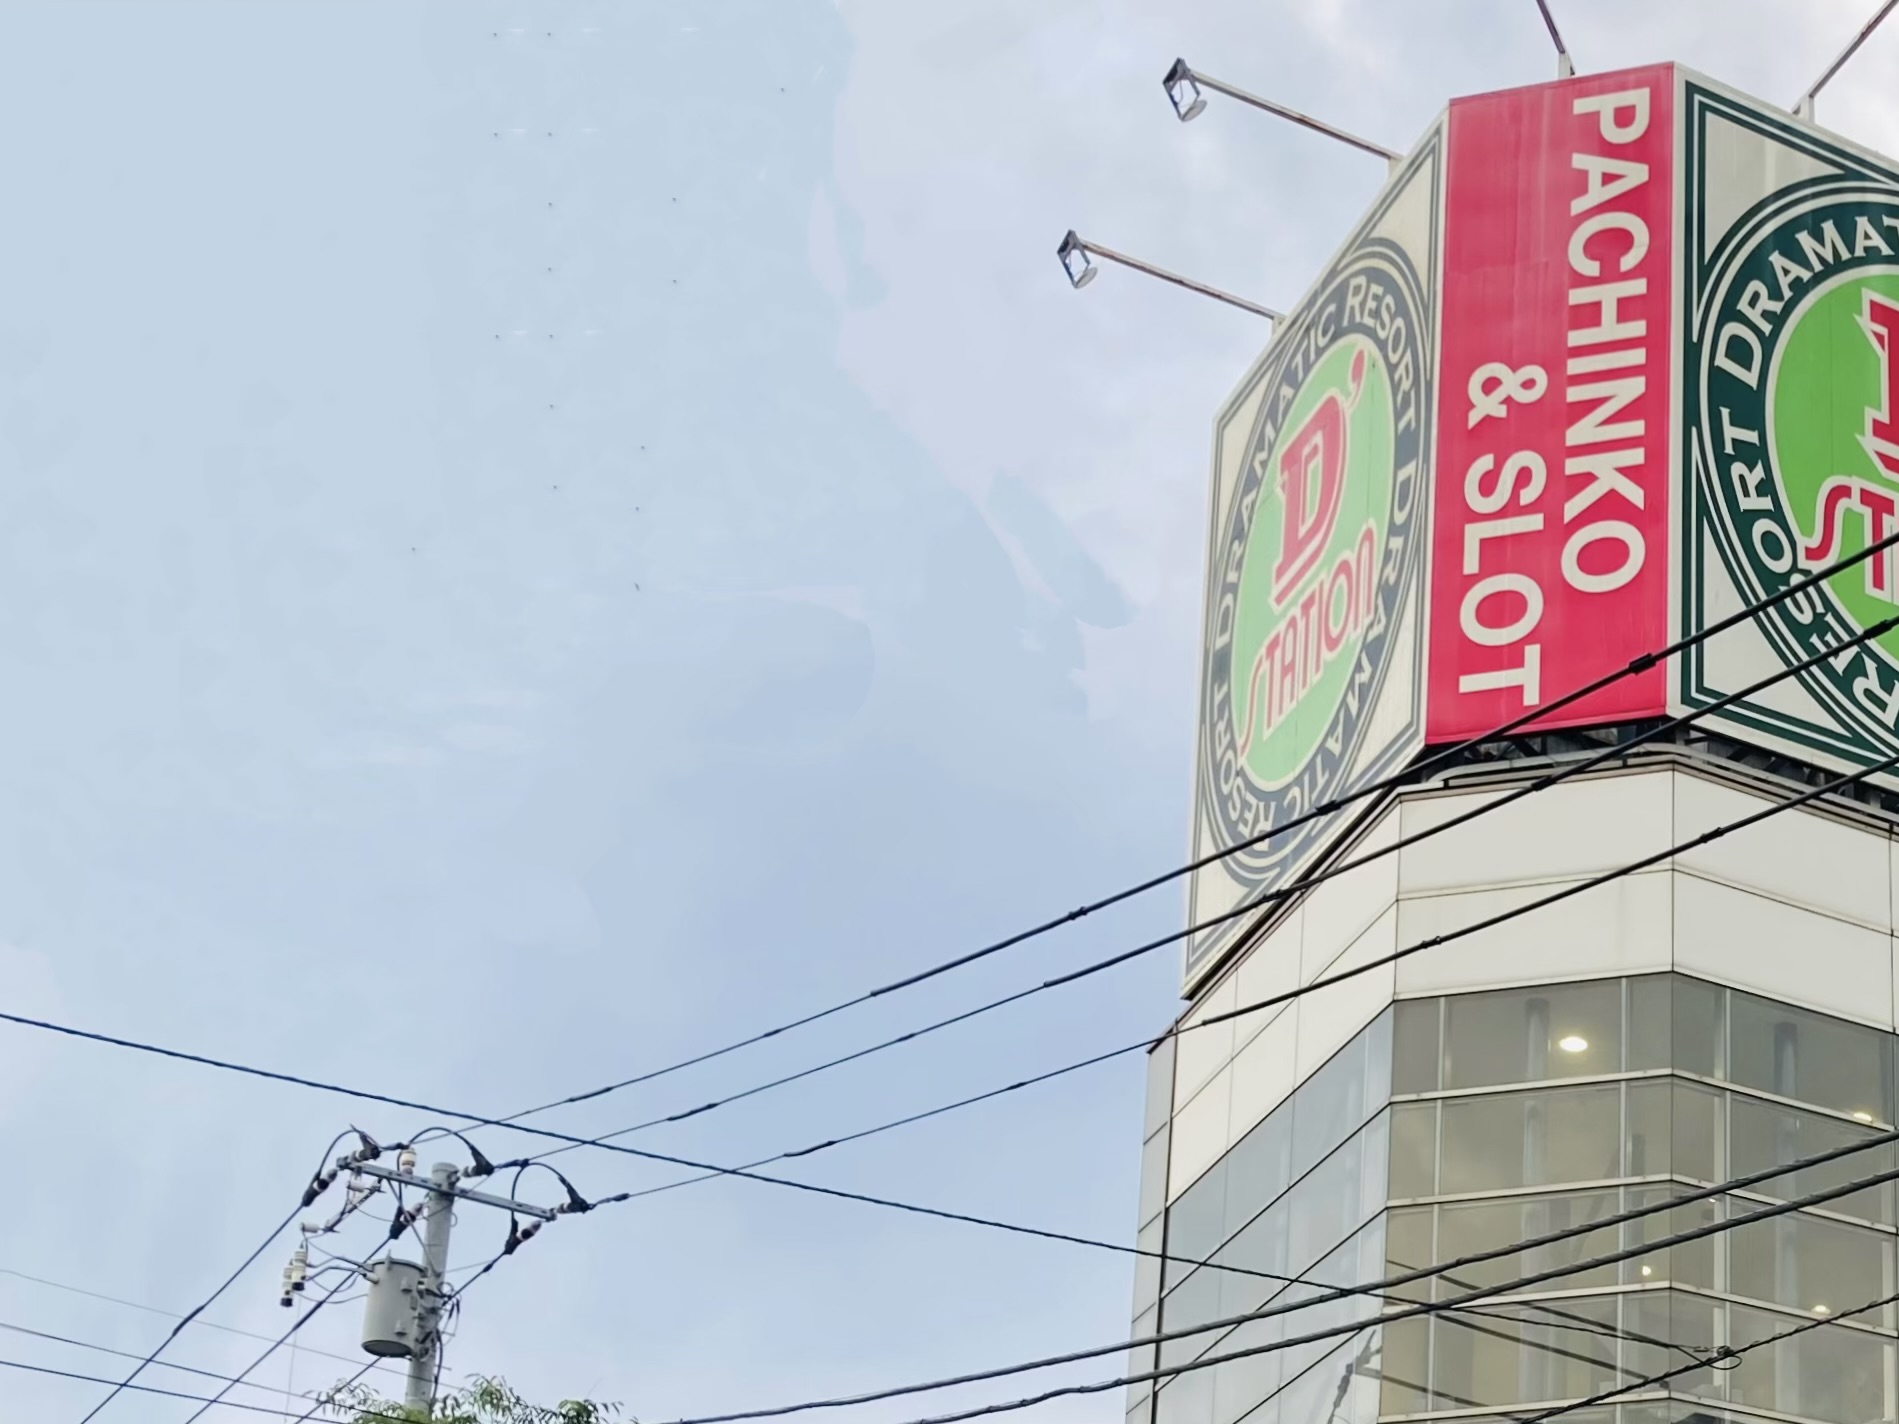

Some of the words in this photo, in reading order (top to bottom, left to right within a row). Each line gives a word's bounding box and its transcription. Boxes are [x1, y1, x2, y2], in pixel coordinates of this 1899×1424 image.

[1215, 303, 1337, 651] DRAMATIC
[1342, 275, 1417, 436] RESORT
[1467, 361, 1548, 430] &
[1560, 84, 1651, 594] PACHINKO
[1238, 526, 1376, 760] STATION
[1458, 450, 1548, 706] SLOT
